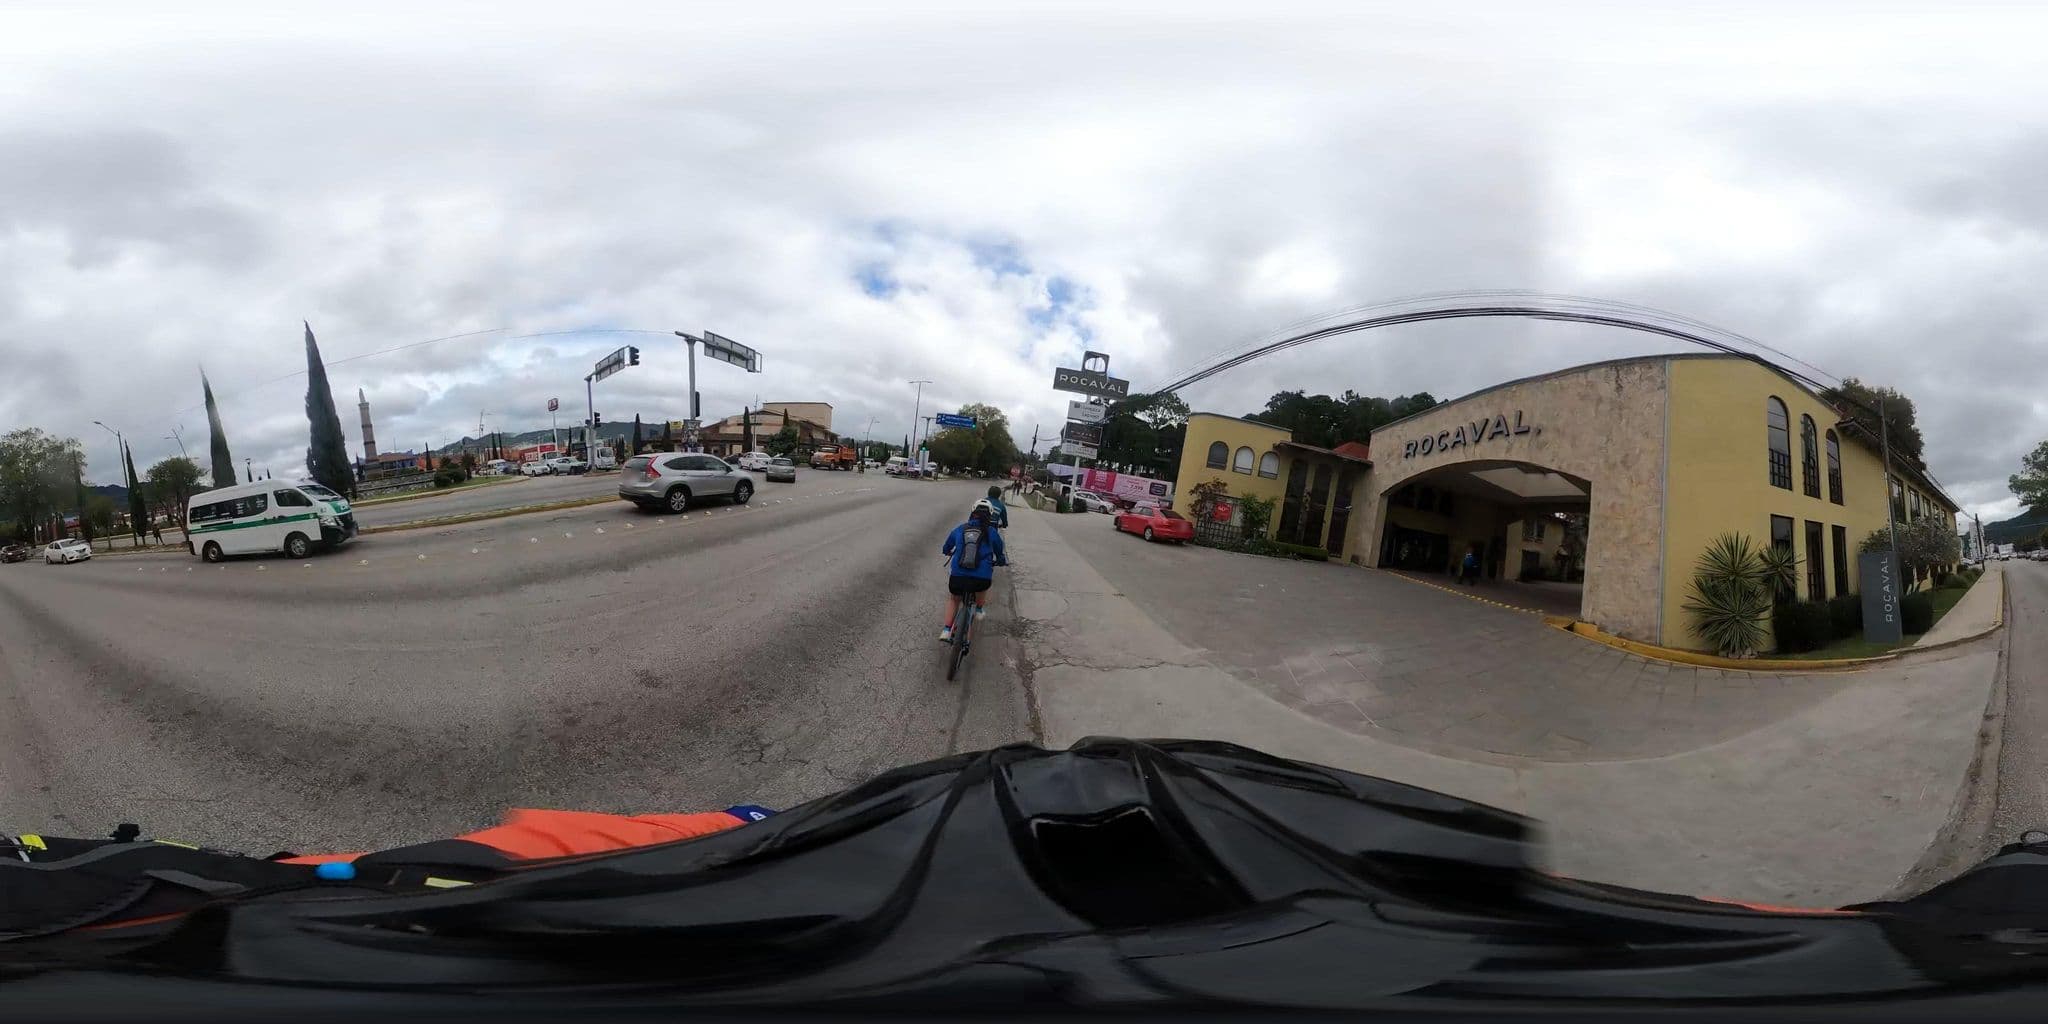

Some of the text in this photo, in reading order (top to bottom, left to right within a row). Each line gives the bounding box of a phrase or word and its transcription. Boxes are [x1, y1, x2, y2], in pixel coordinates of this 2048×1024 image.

[1060, 373, 1124, 394] ROCAVAL
[1403, 410, 1530, 460] ROCAVAL
[1881, 556, 1894, 622] ROCAVAL
